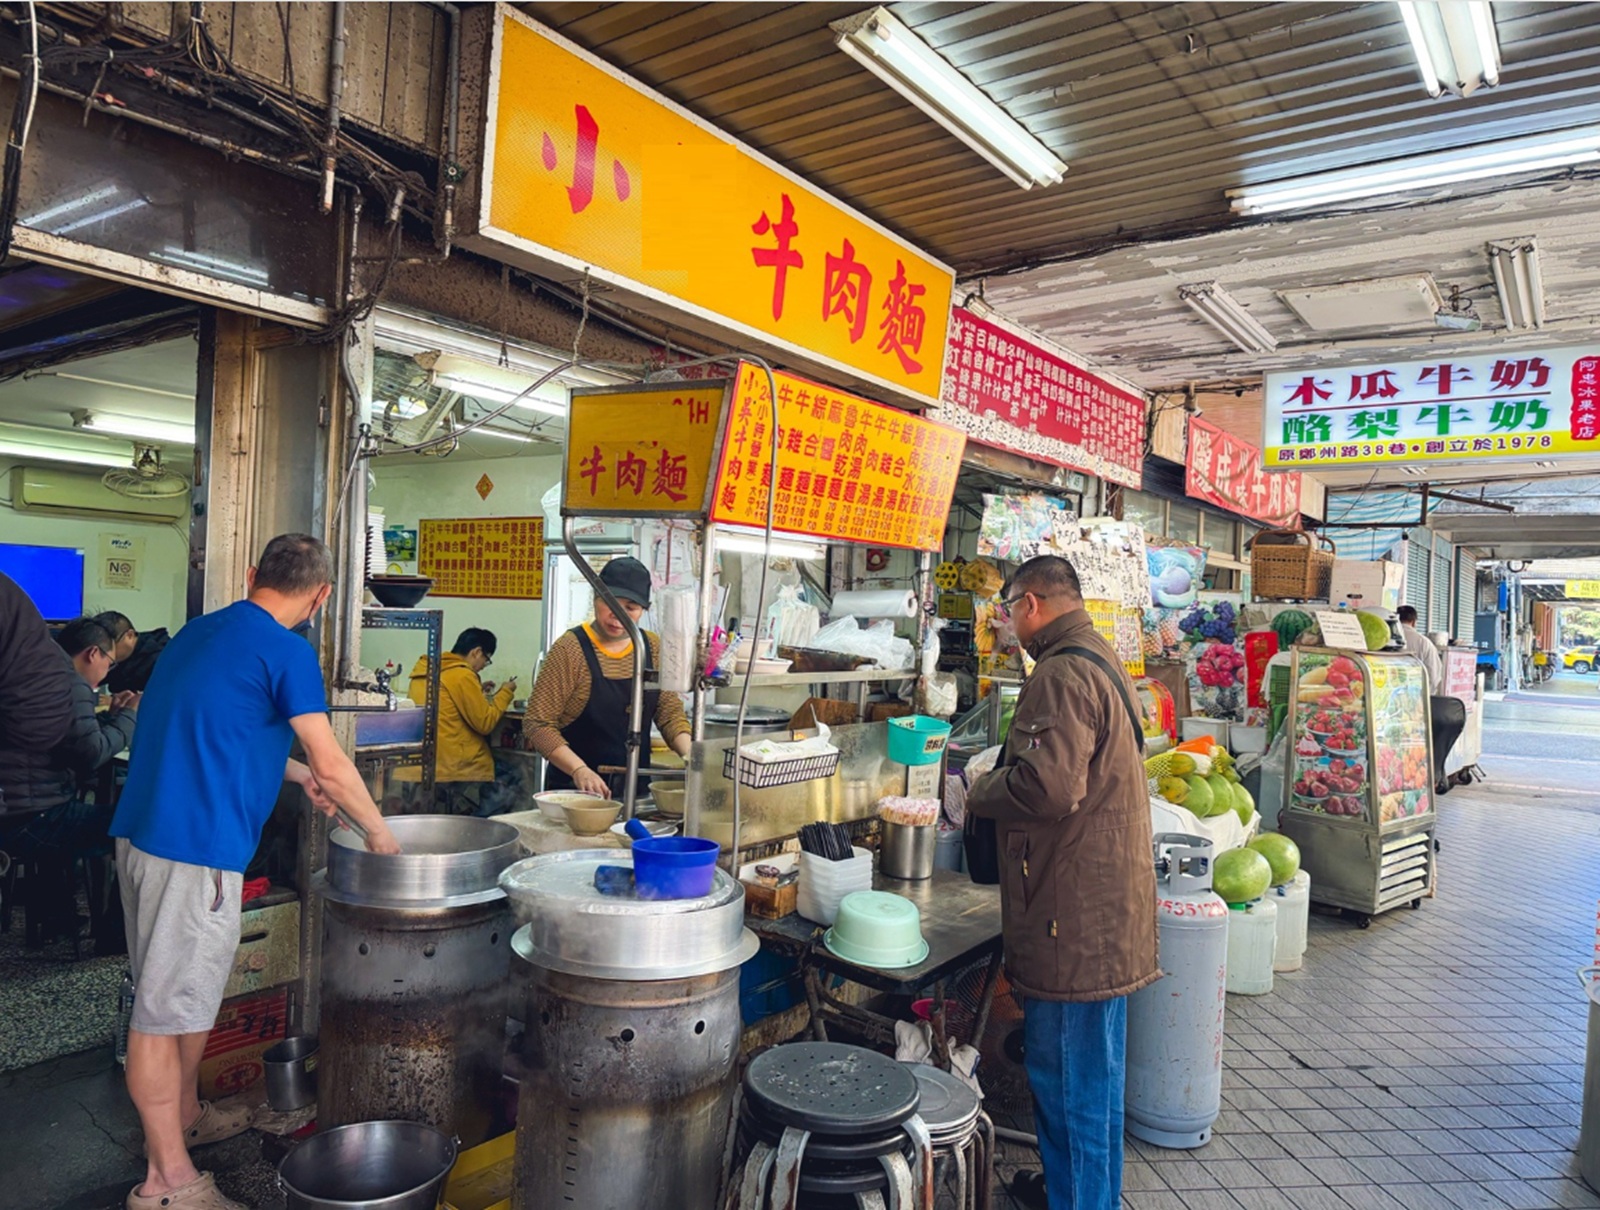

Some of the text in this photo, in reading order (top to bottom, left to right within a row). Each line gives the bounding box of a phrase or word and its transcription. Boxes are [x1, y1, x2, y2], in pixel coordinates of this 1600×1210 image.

[541, 103, 630, 214] 小
[750, 193, 926, 376] 牛肉麵
[1282, 357, 1552, 405] 木瓜牛奶
[1282, 399, 1551, 444] 酪梨牛奶
[1576, 360, 1598, 438] 阿忠冰果老店
[579, 445, 688, 502] 牛肉麵
[720, 371, 758, 511] 小吳牛肉麵
[779, 389, 810, 491] 牛雜麵
[795, 394, 827, 494] 綜合麵
[857, 413, 886, 505] 牛肉湯
[871, 417, 899, 508] 牛雜湯
[885, 421, 913, 511] 綜合湯
